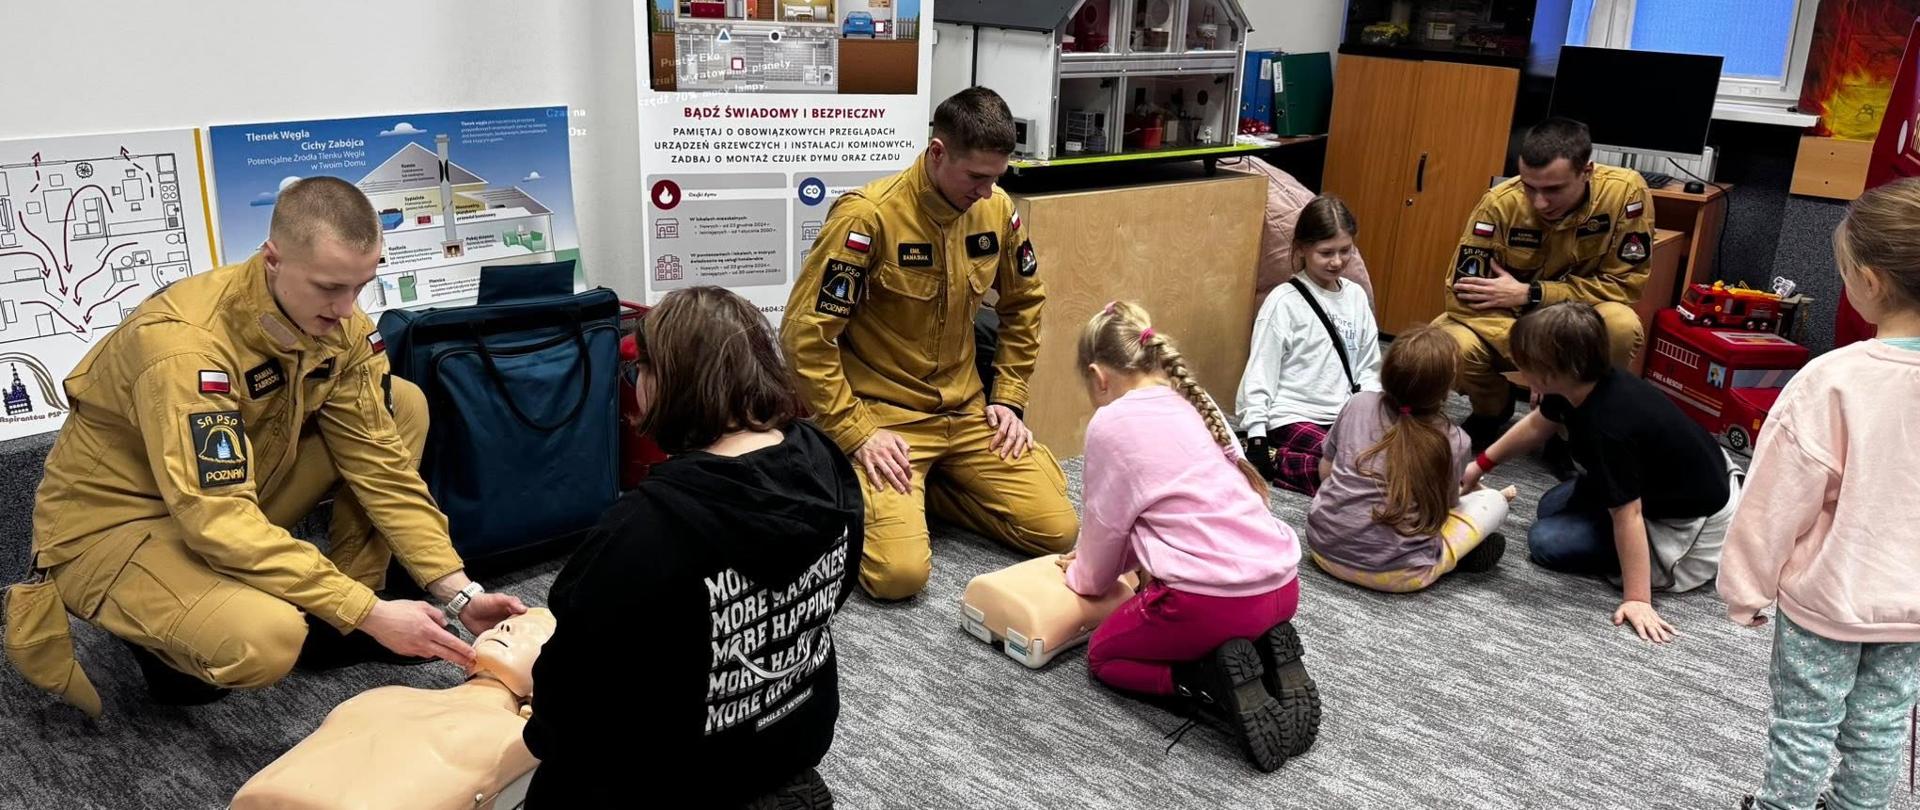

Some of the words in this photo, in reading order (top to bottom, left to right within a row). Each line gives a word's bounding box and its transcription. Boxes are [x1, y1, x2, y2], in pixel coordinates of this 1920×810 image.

[546, 109, 569, 118] Cza
[684, 105, 720, 120] BĄDŹ
[725, 105, 798, 118] ŚWIADOMY
[803, 108, 807, 118] I
[812, 108, 886, 118] BEZPIECZNY
[246, 131, 279, 142] Tlenek
[280, 129, 310, 140] Węgla
[673, 128, 722, 137] PAMIĘTAJ
[727, 128, 733, 136] O
[738, 128, 826, 137] OBOWIĄZKOWYCH
[830, 128, 895, 137] PRZEGLĄDACH
[301, 140, 326, 151] Cichy
[328, 138, 364, 149] Zabójca
[654, 140, 709, 151] URZĄDZEŃ
[713, 141, 780, 149] GRZEWCZYCH
[791, 141, 844, 149] INSTALACJI
[848, 140, 915, 149] KOMINOWYCH,
[248, 155, 293, 167] Potencjalne
[319, 151, 342, 160] Tlenku
[343, 149, 365, 160] Węgla
[319, 161, 342, 169] Twoim
[344, 159, 366, 168] Domu
[671, 155, 710, 163] ZADBAJ
[714, 155, 722, 163] O
[726, 153, 768, 163] MONTAŻ
[772, 155, 807, 163] CZUJEK
[810, 154, 838, 162] DYMU
[842, 154, 866, 162] ORAZ
[870, 153, 900, 161] CZADU
[805, 187, 818, 195] CO
[711, 588, 769, 639] MORE
[704, 688, 764, 733] MORE
